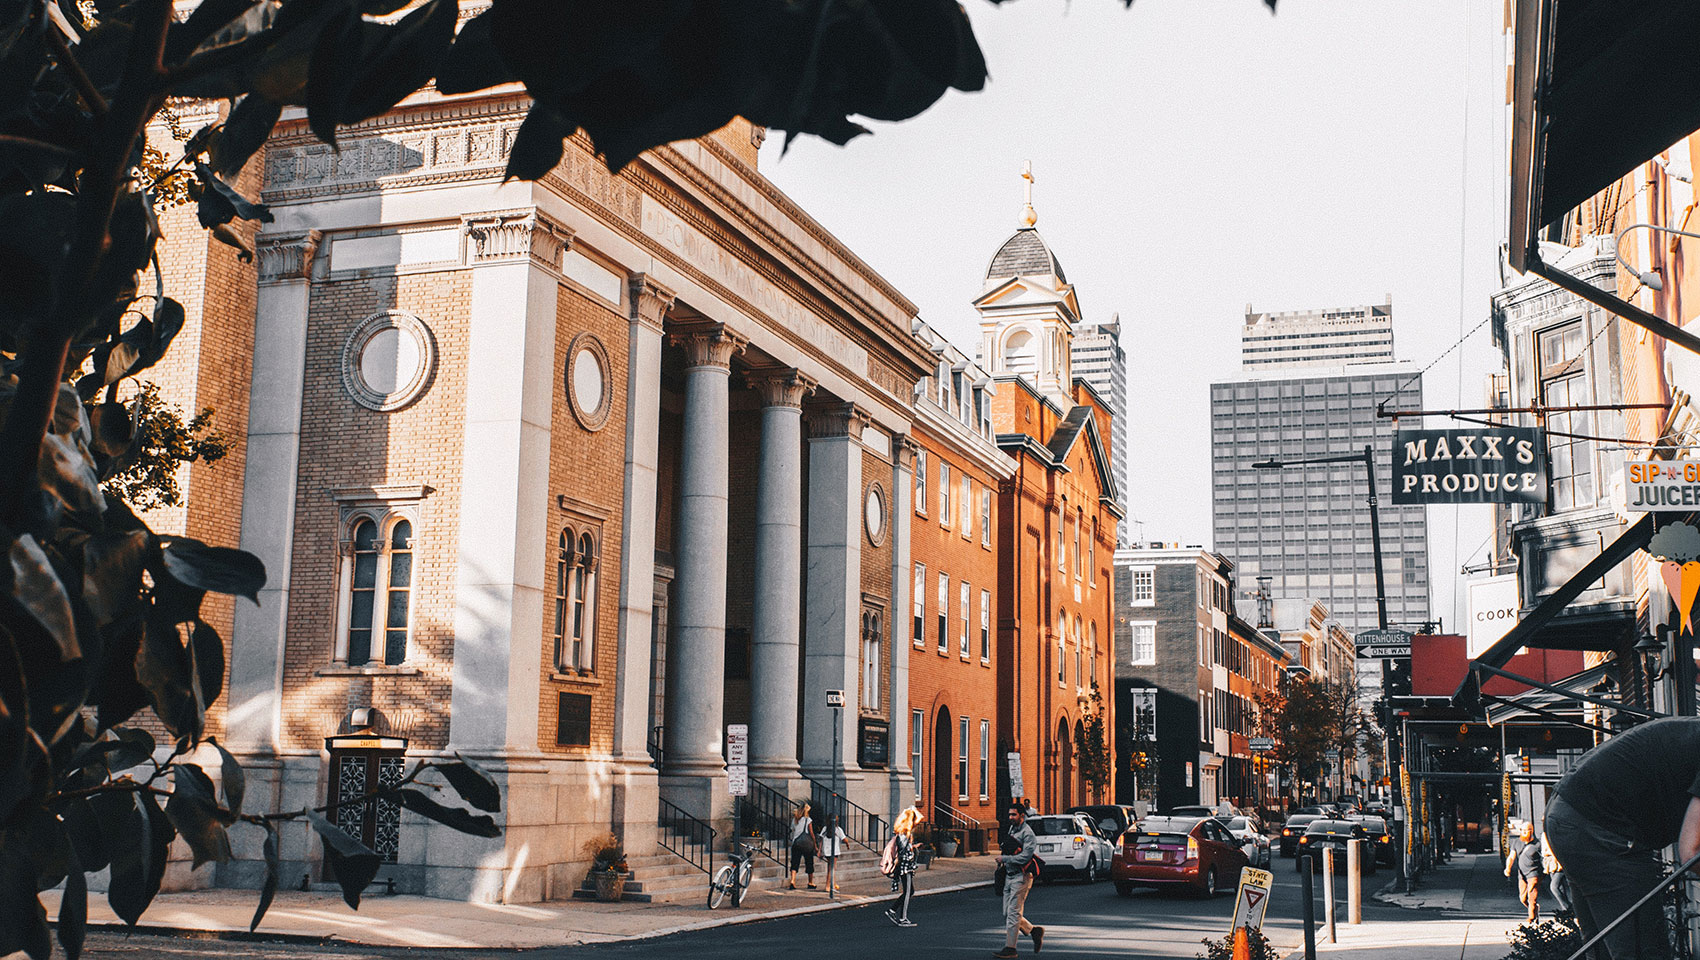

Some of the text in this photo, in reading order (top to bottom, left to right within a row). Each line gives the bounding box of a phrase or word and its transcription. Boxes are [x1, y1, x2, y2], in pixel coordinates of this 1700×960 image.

[1403, 435, 1534, 467] MAXX'S
[1401, 472, 1537, 494] PRODUCE
[1477, 607, 1515, 622] COOK
[1356, 634, 1405, 644] RITTENHOUSE
[1390, 647, 1408, 655] WAY
[1248, 869, 1268, 881] STATE
[1249, 878, 1264, 886] LAW
